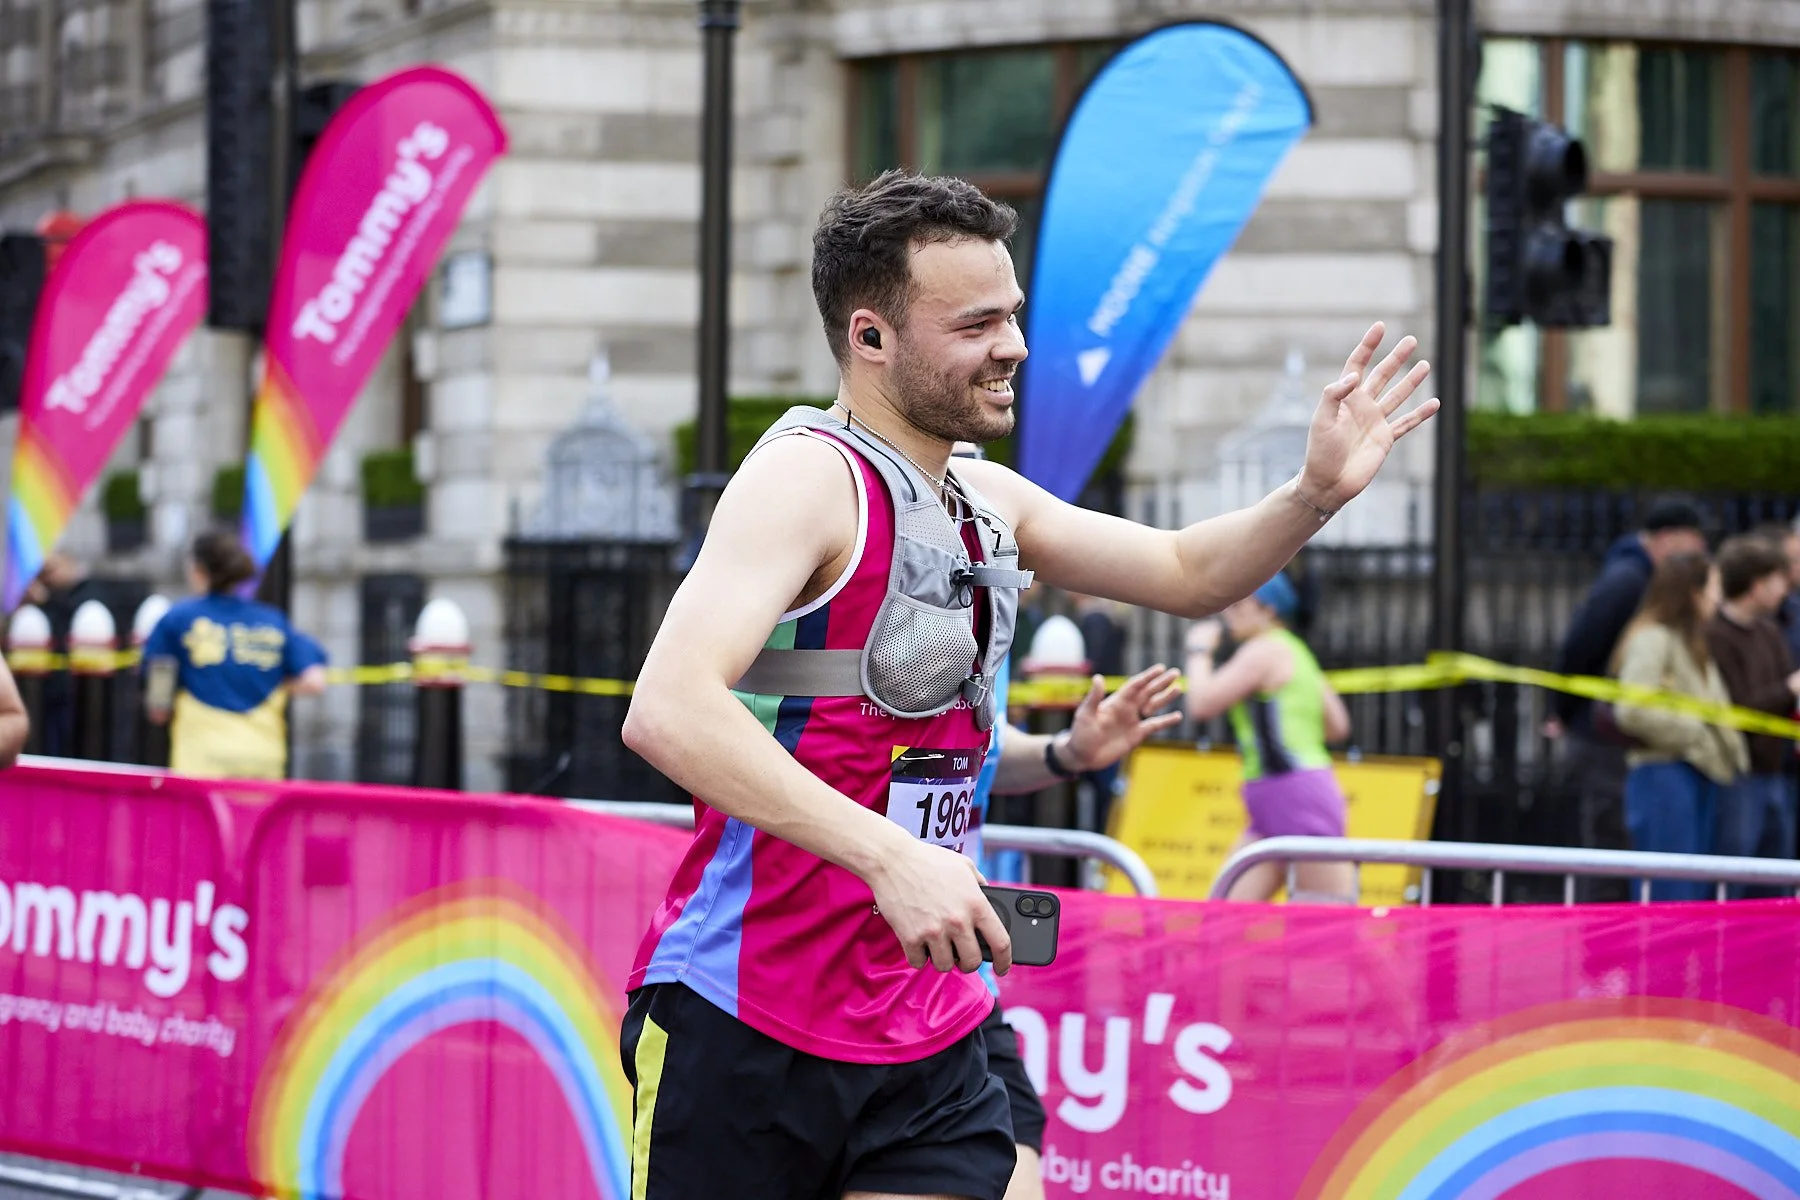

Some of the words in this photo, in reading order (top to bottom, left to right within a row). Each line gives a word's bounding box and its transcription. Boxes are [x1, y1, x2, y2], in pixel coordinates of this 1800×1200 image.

[293, 121, 448, 343] Tommy's
[46, 240, 182, 414] Tommy's
[860, 703, 888, 717] The
[953, 757, 968, 770] TOM
[0, 880, 249, 997] mmy's
[1100, 1152, 1230, 1200] charity
